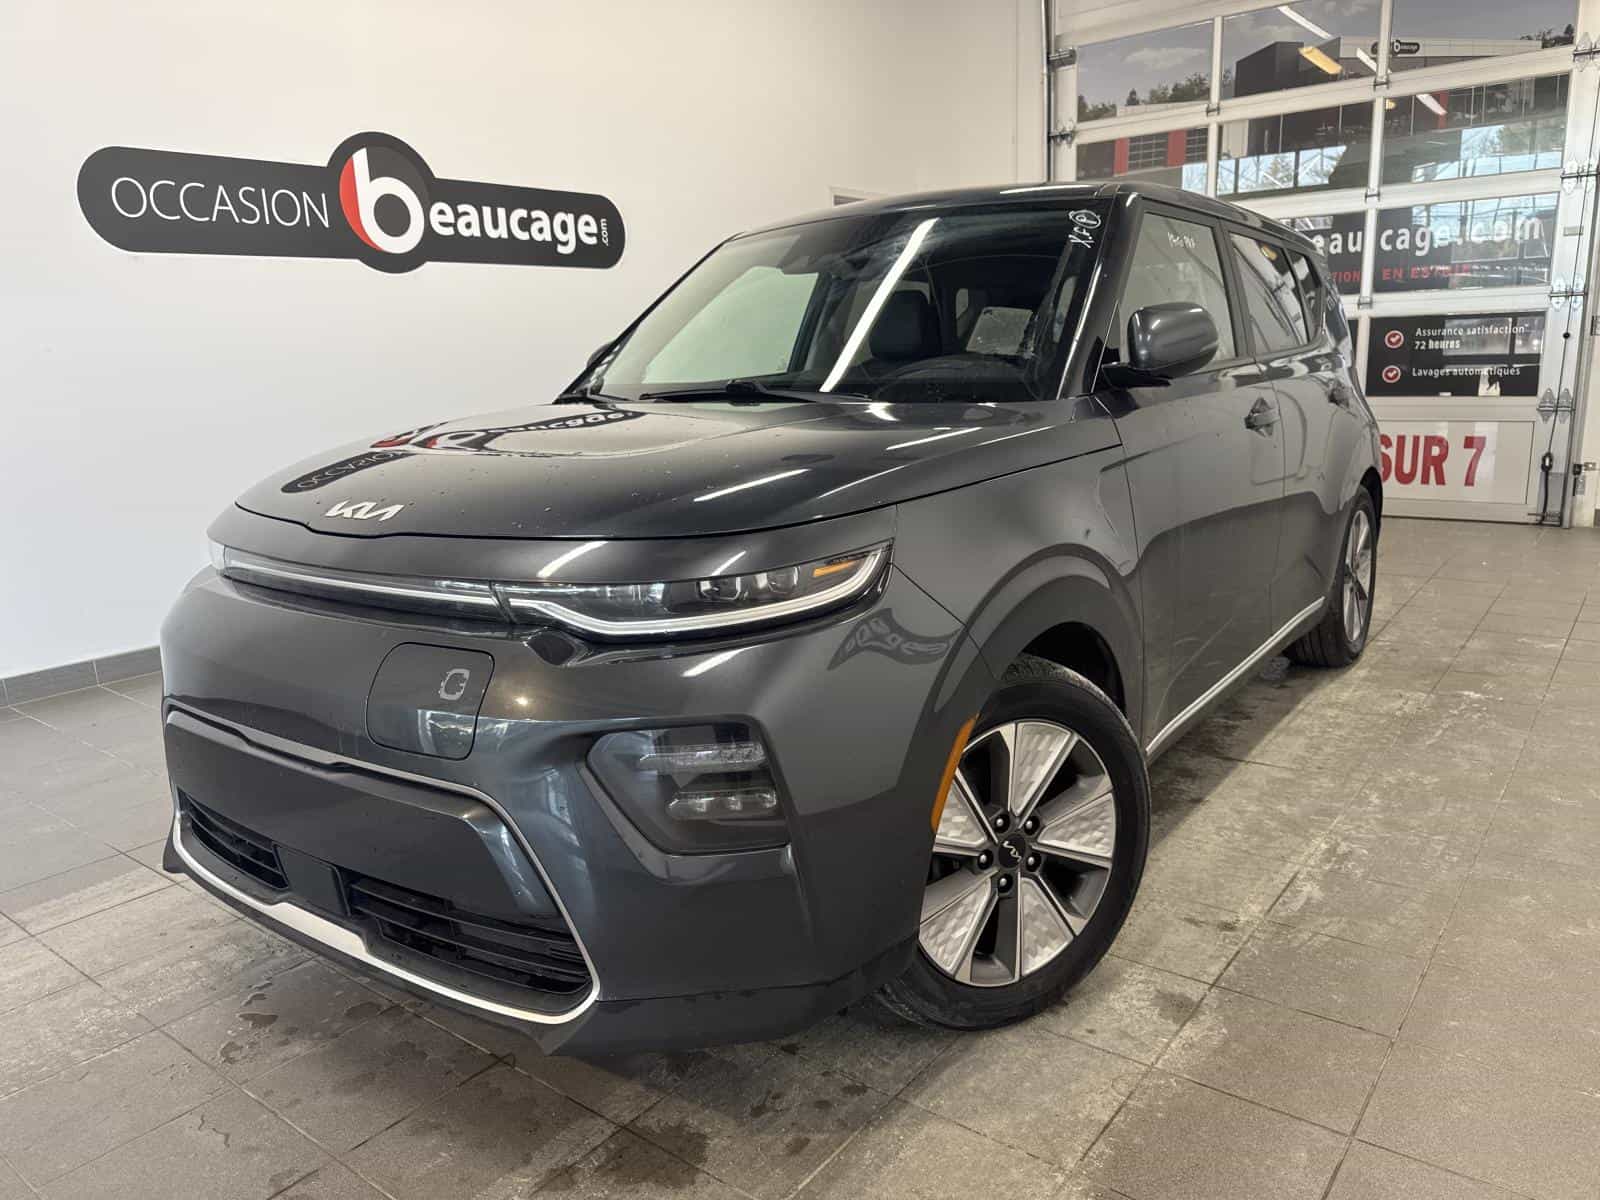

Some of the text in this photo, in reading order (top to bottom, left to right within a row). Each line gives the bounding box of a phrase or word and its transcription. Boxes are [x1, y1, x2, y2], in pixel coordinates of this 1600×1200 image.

[111, 176, 330, 228] OCCASION
[1382, 267, 1403, 281] EN
[1415, 327, 1464, 337] Assurance
[1414, 339, 1461, 350] 72 heures
[1412, 366, 1521, 379] Lavages automatiques
[1379, 433, 1487, 487] SUR 7
[324, 499, 406, 522] KIA
